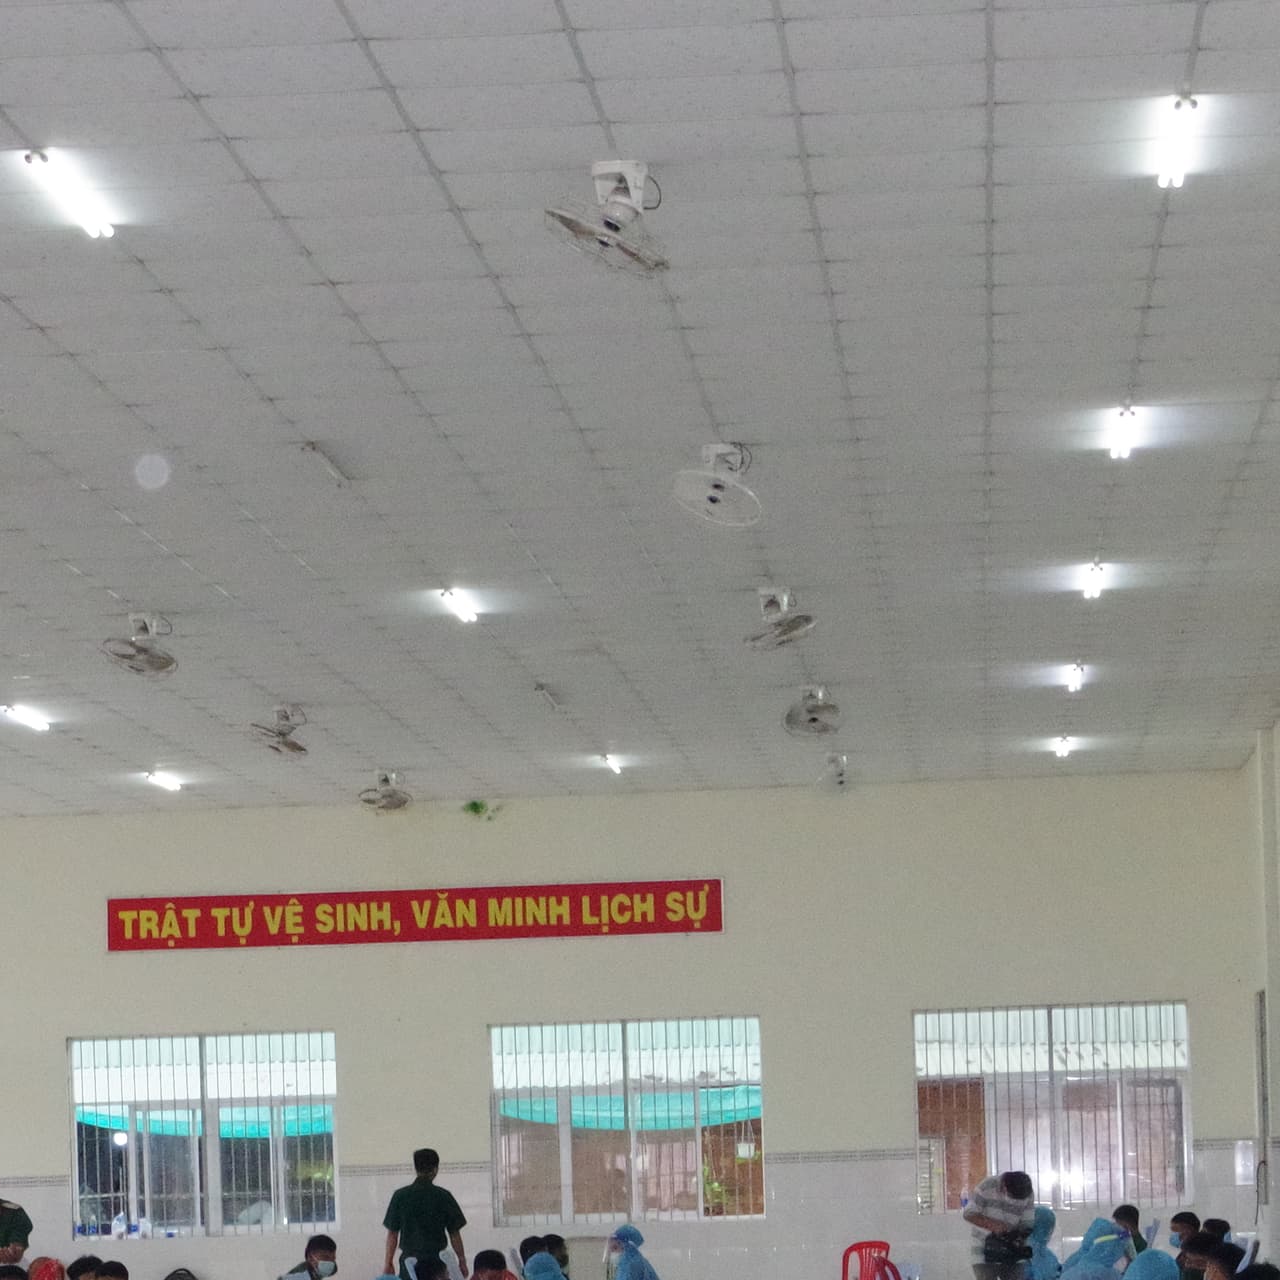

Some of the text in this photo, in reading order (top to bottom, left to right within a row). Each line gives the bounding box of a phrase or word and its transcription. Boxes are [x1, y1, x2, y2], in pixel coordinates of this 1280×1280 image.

[118, 884, 710, 947] TRẬT TỰ VỆ SINH, VĂN MINH LỊCH SỰ
